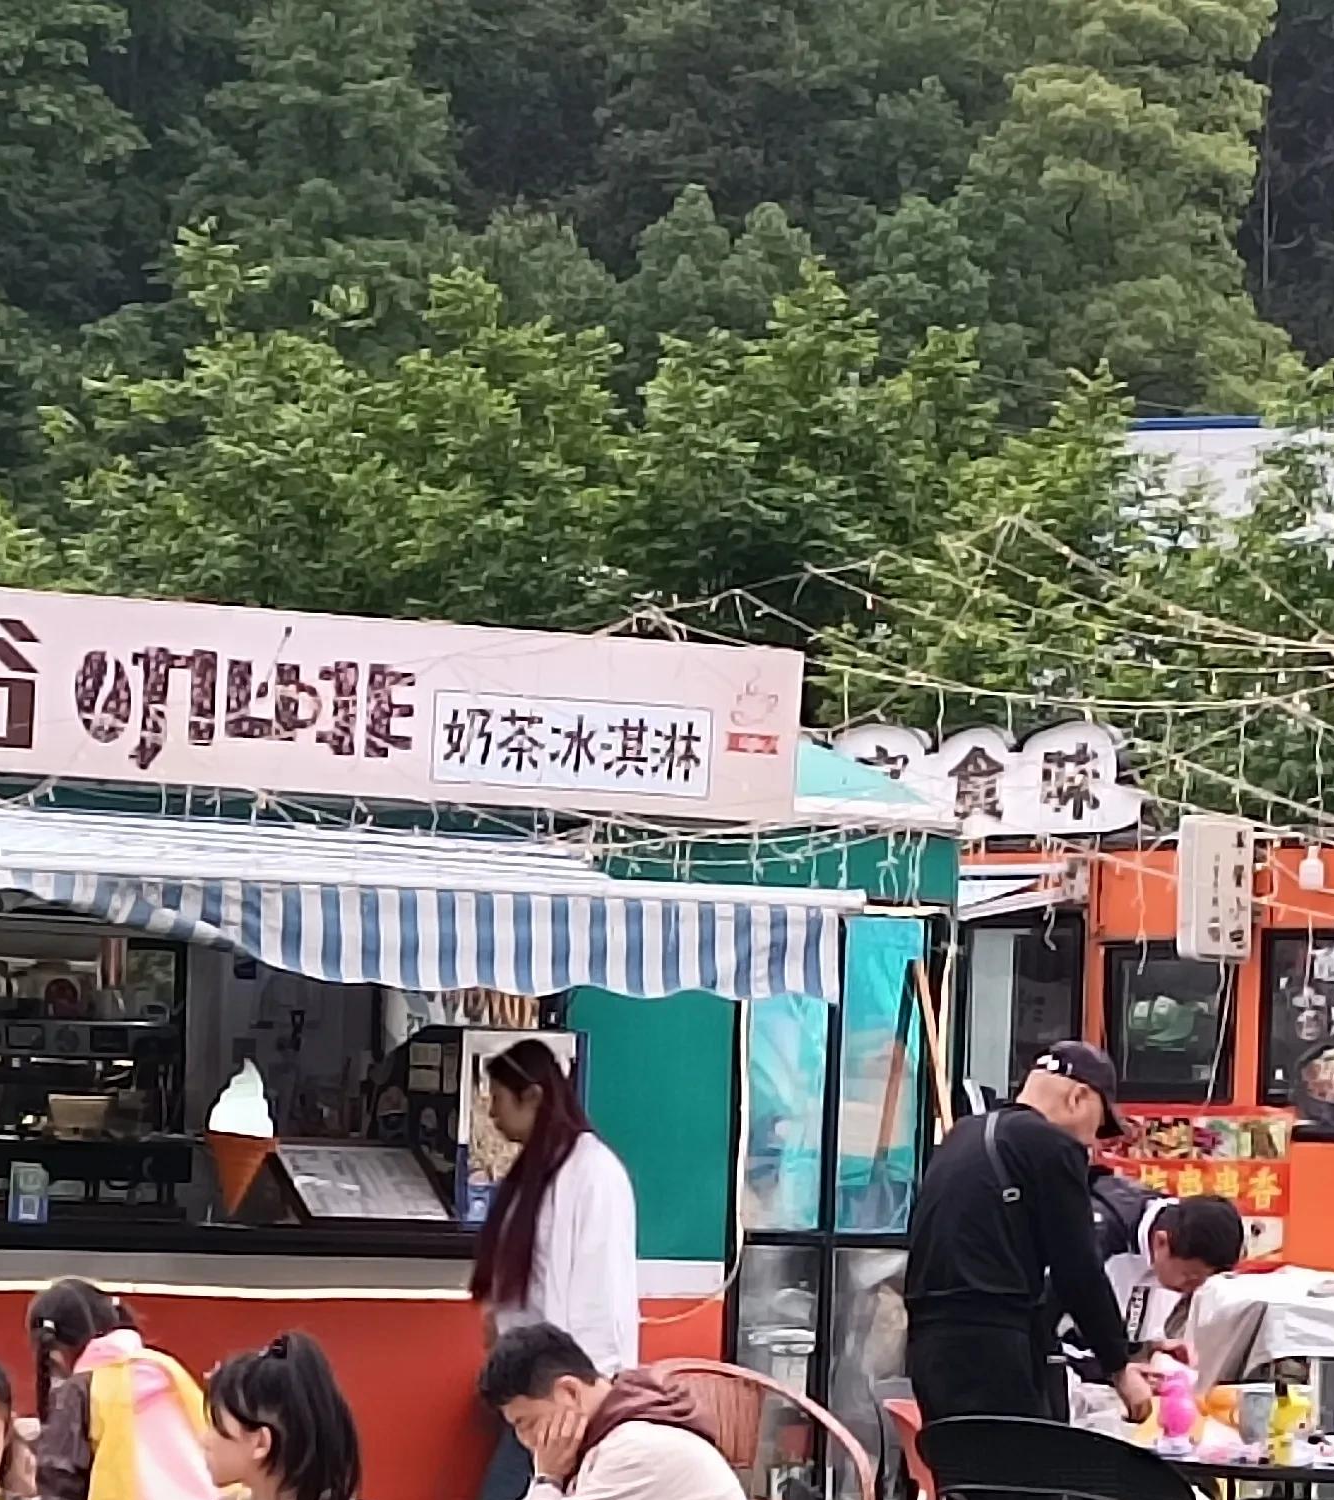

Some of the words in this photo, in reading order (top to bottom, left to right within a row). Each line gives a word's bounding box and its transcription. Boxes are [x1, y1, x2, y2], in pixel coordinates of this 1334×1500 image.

[442, 708, 701, 783] 奶茶冰淇淋
